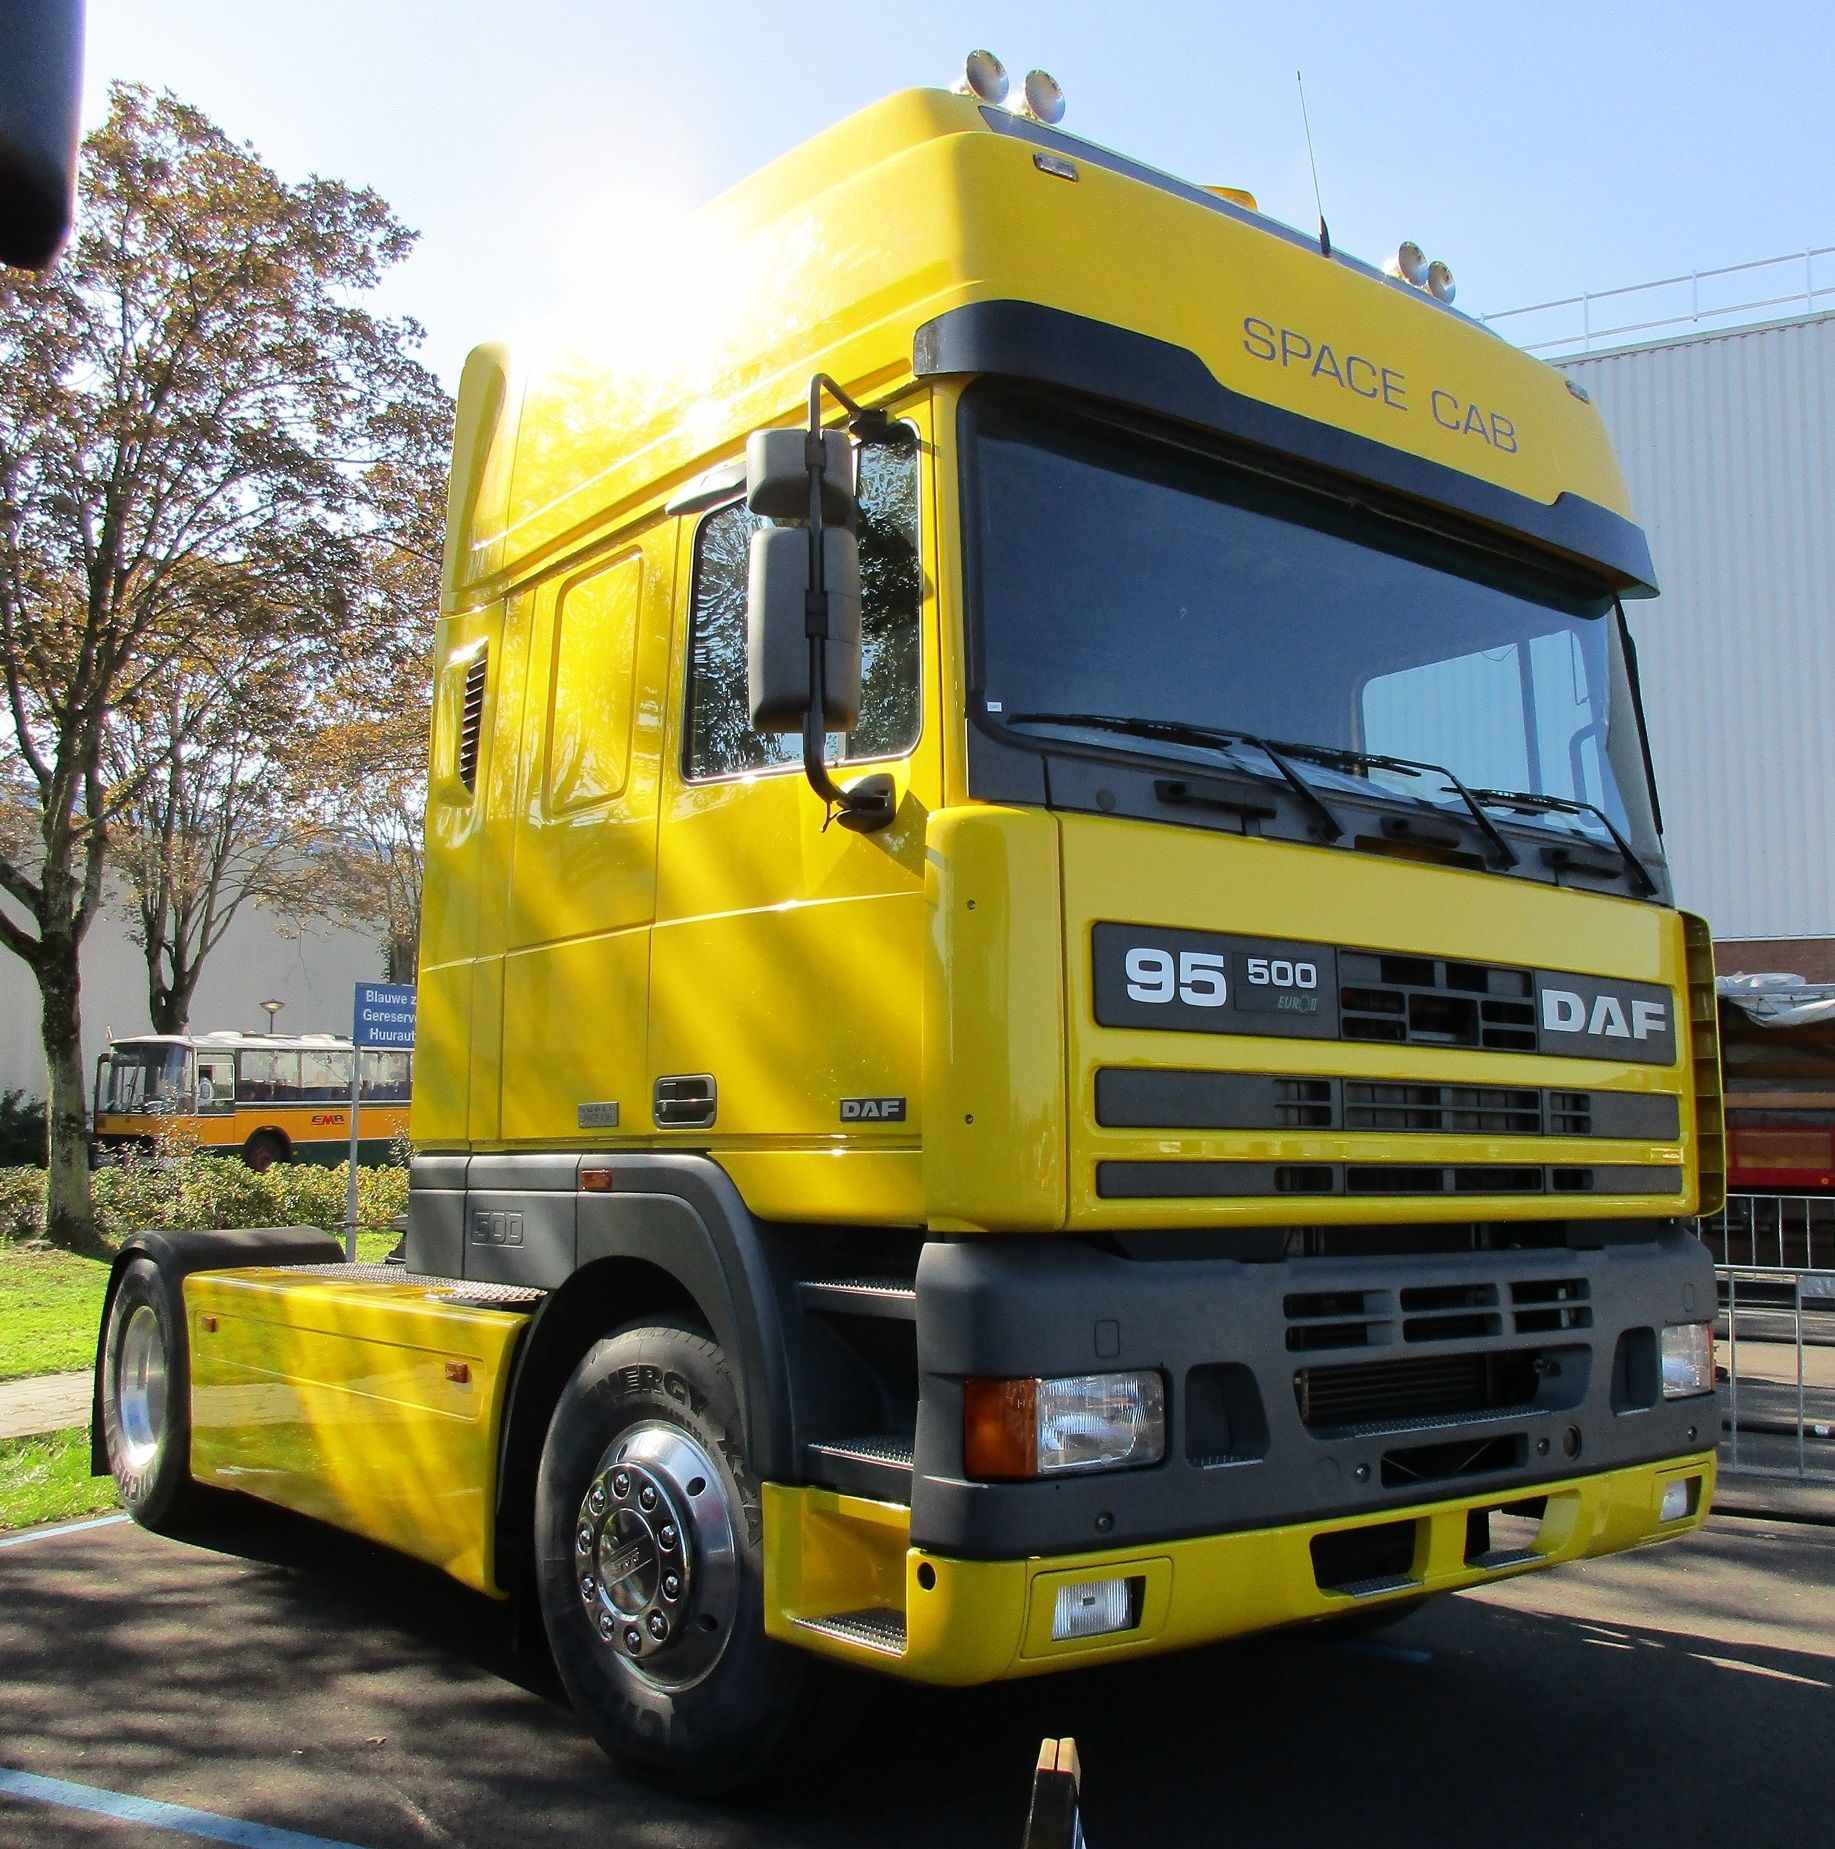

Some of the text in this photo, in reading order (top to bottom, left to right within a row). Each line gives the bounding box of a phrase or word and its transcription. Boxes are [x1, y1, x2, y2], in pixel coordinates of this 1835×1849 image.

[1243, 317, 1517, 454] SPACE CAB
[1125, 948, 1317, 1007] 95 500
[366, 989, 408, 1004] Blauwe
[363, 1008, 417, 1023] Gereserv
[1542, 989, 1666, 1040] DAF
[842, 1100, 900, 1118] DAF
